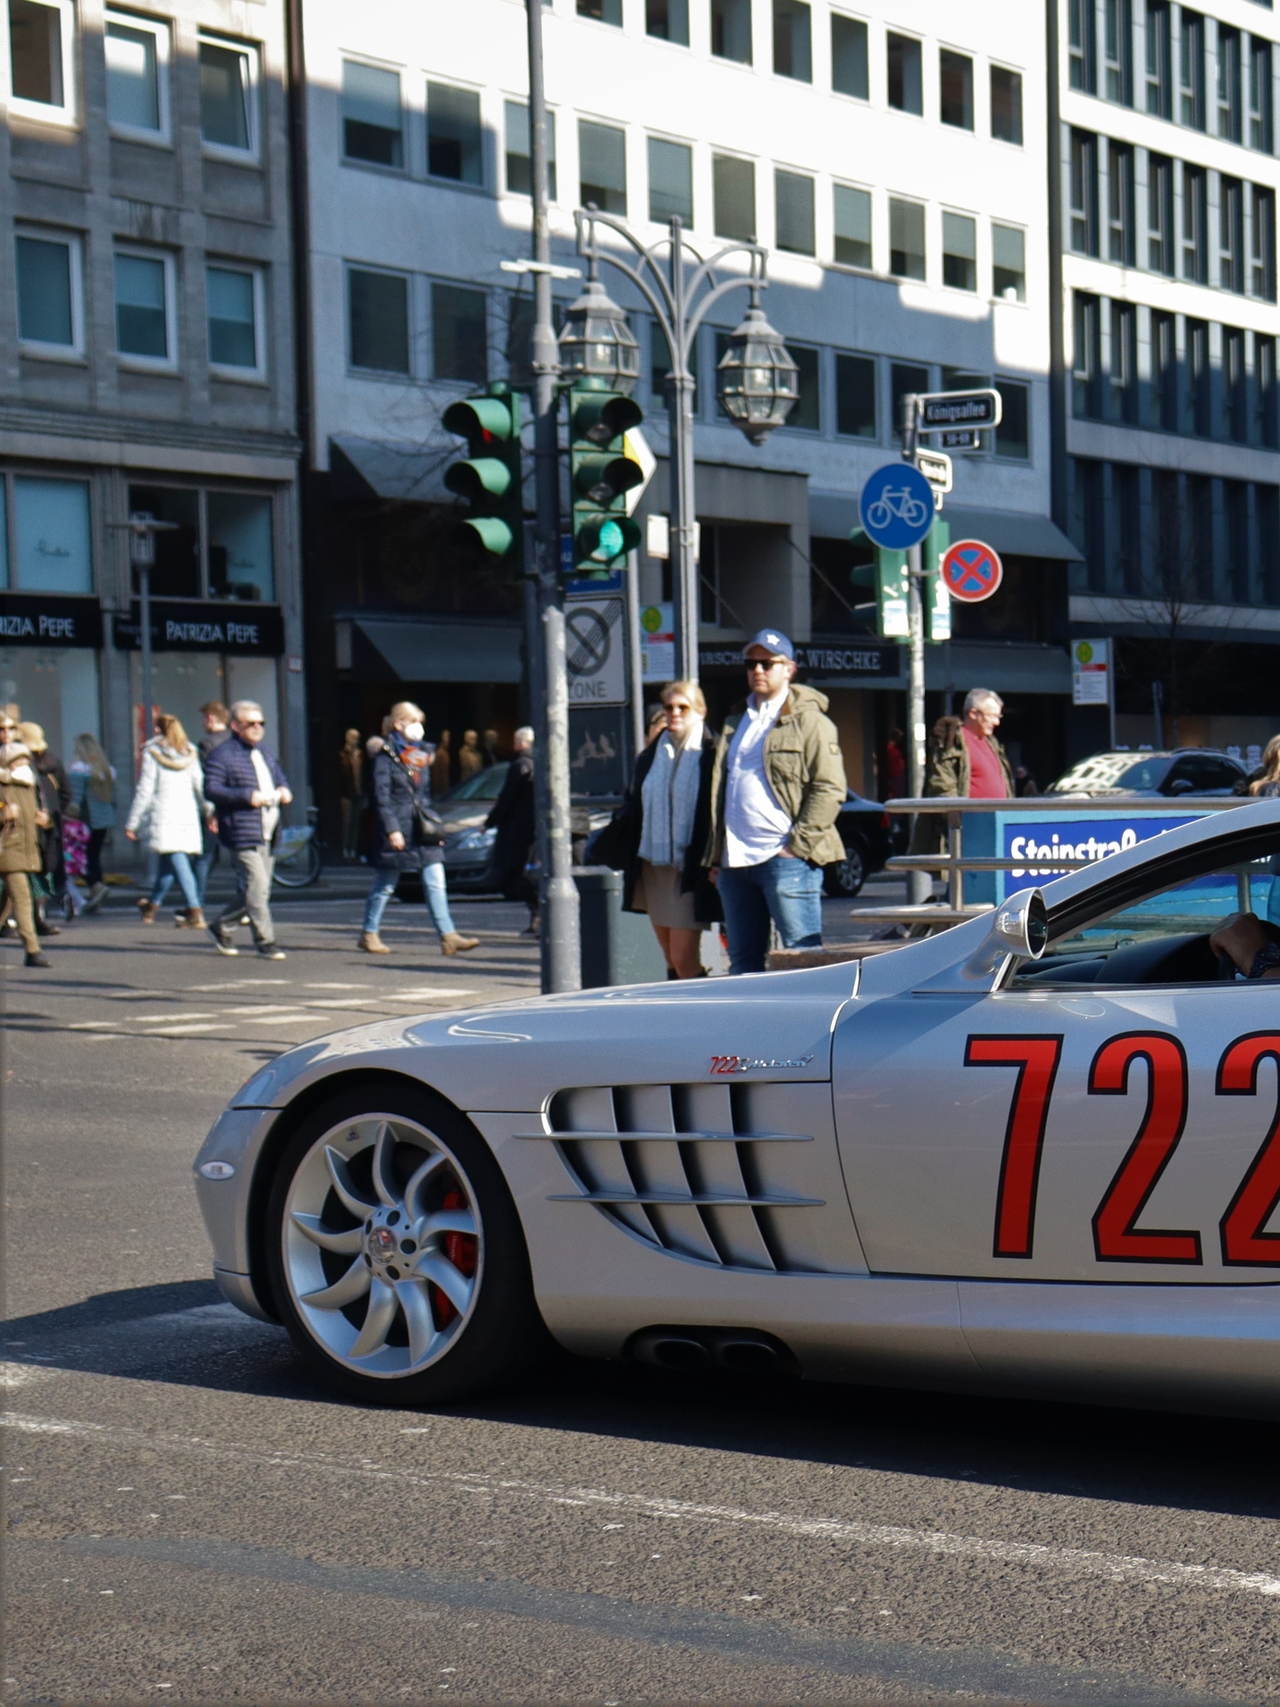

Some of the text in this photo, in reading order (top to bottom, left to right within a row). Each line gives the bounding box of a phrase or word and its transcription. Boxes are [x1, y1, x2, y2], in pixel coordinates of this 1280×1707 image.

[39, 615, 76, 638] PEPE
[166, 621, 224, 642] PATRIZIA
[226, 622, 259, 643] PEPE
[1011, 829, 1147, 877] Steinstra
[709, 1056, 740, 1074] 722
